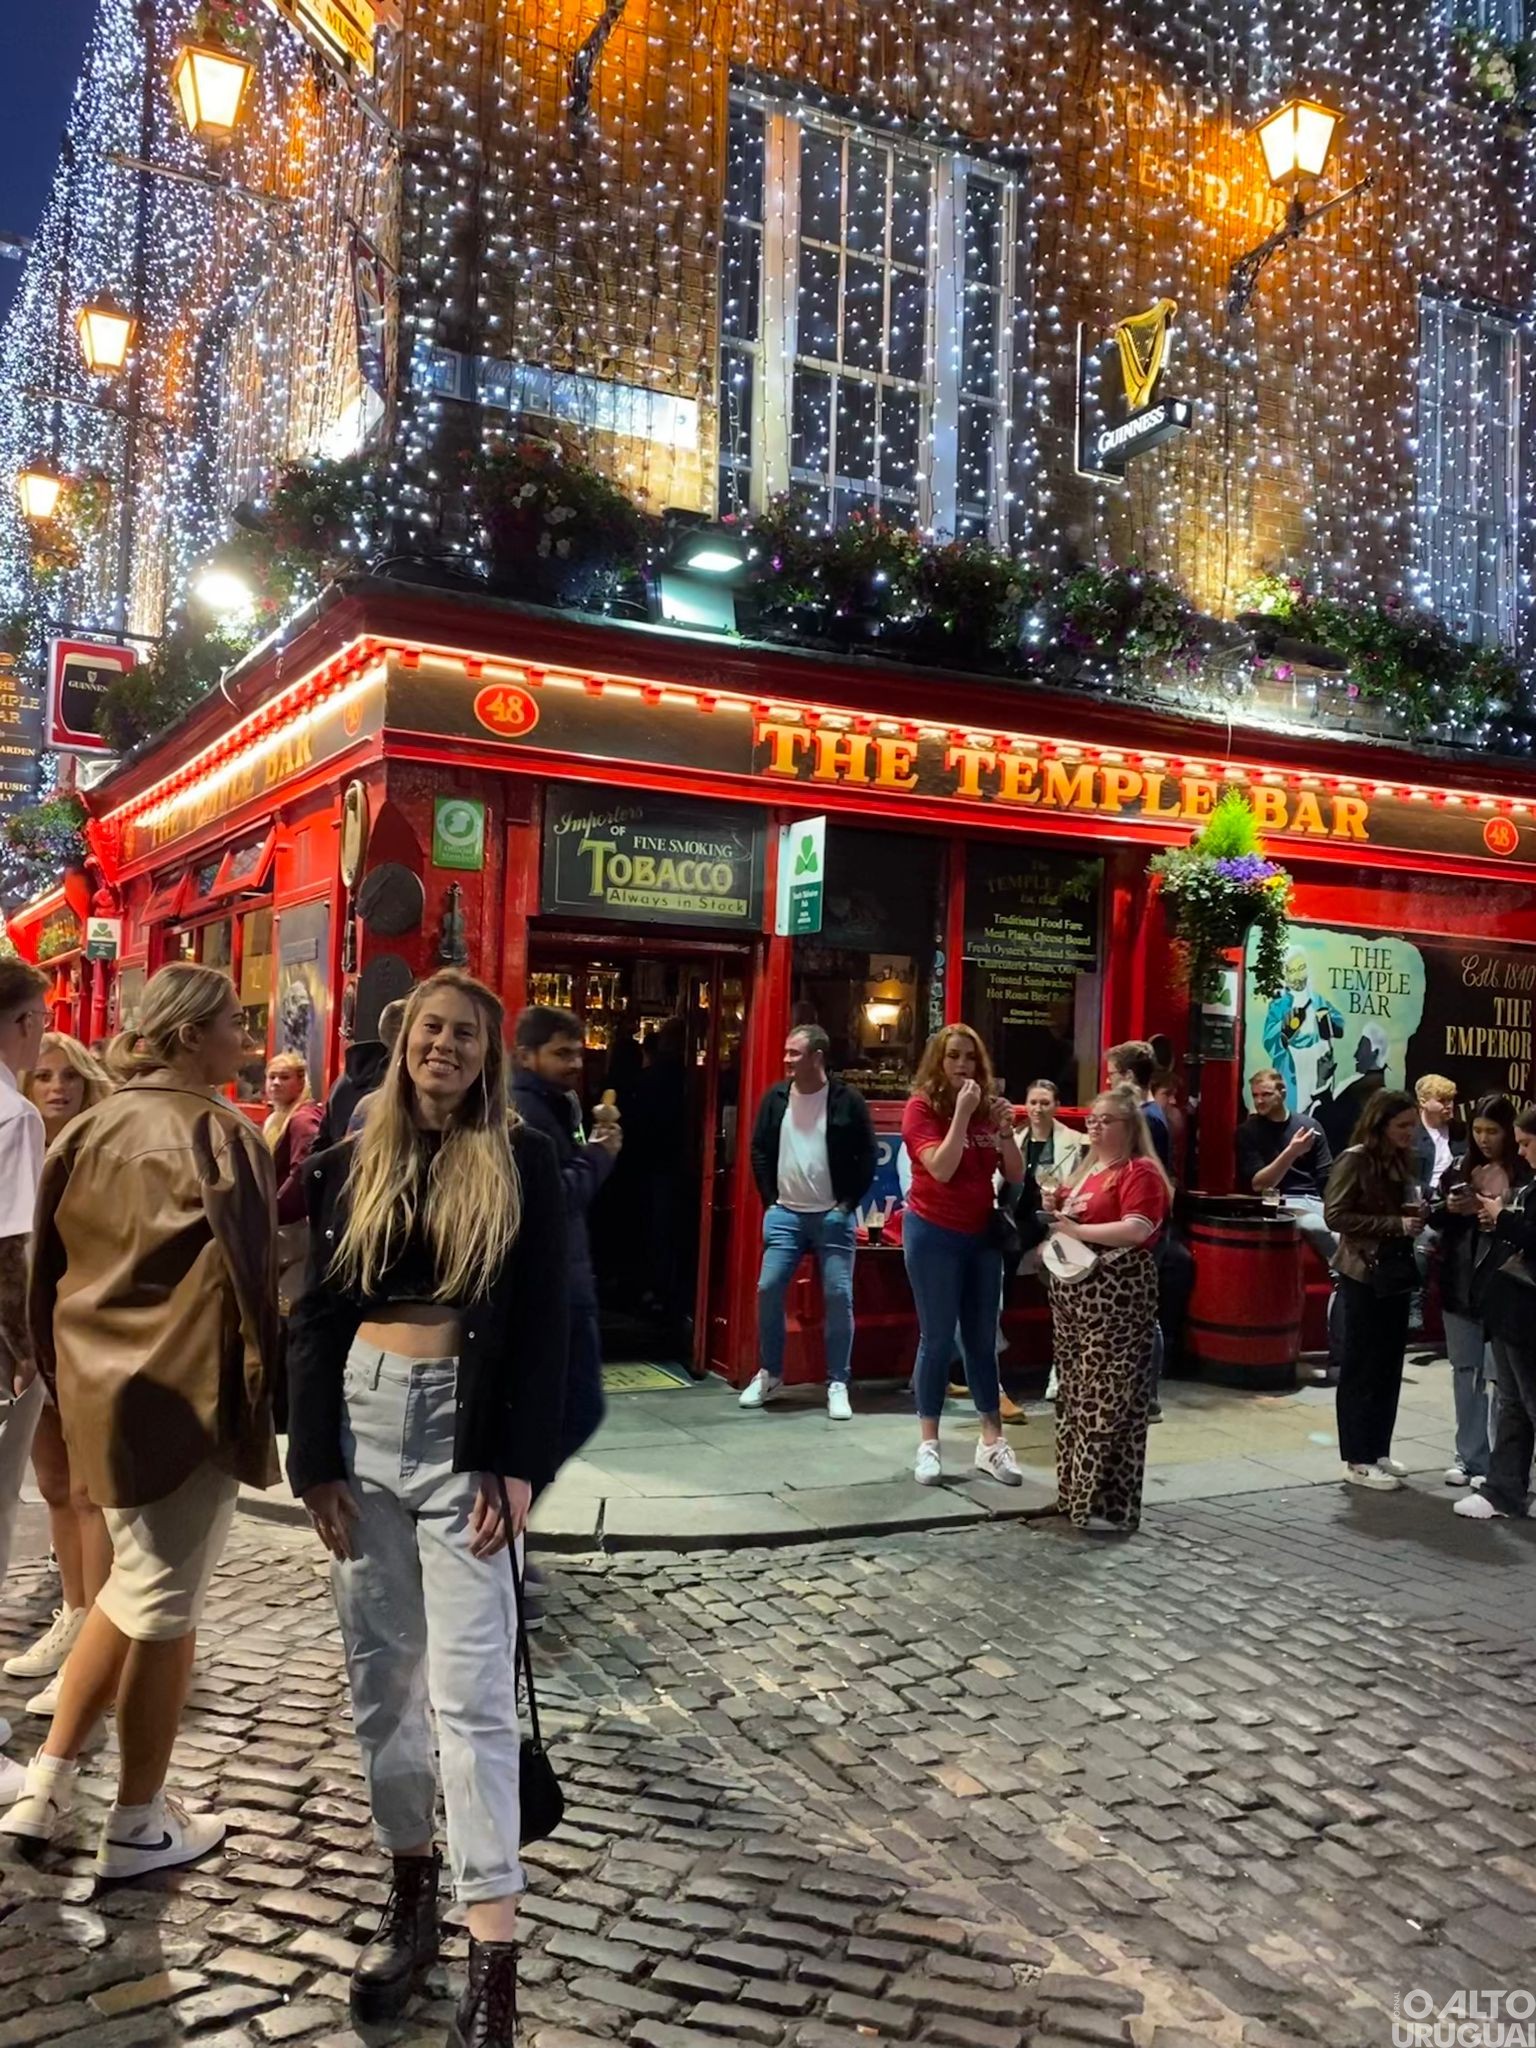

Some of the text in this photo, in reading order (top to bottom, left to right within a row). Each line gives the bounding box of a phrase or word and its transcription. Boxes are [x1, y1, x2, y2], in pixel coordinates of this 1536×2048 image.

[326, 4, 367, 61] MUSIC
[1098, 404, 1166, 453] GUINNESS
[0, 681, 16, 691] HE
[485, 691, 525, 723] 48
[756, 722, 1370, 842] THE TEMPLE BAR
[553, 806, 644, 838] Importers
[610, 825, 626, 836] OF
[1488, 824, 1512, 848] 48
[633, 835, 733, 858] FINE SMOKING
[577, 838, 734, 897] TOBACCO
[609, 889, 745, 914] Always in Stock
[993, 913, 1039, 927] Traditional
[1041, 917, 1062, 929] Food
[1350, 945, 1393, 970] THE
[1328, 967, 1411, 995] TEMPLE
[1349, 992, 1391, 1018] BAR
[1493, 997, 1532, 1028] THE
[1445, 1025, 1532, 1061] EMPEROR
[1508, 1061, 1531, 1092] OF
